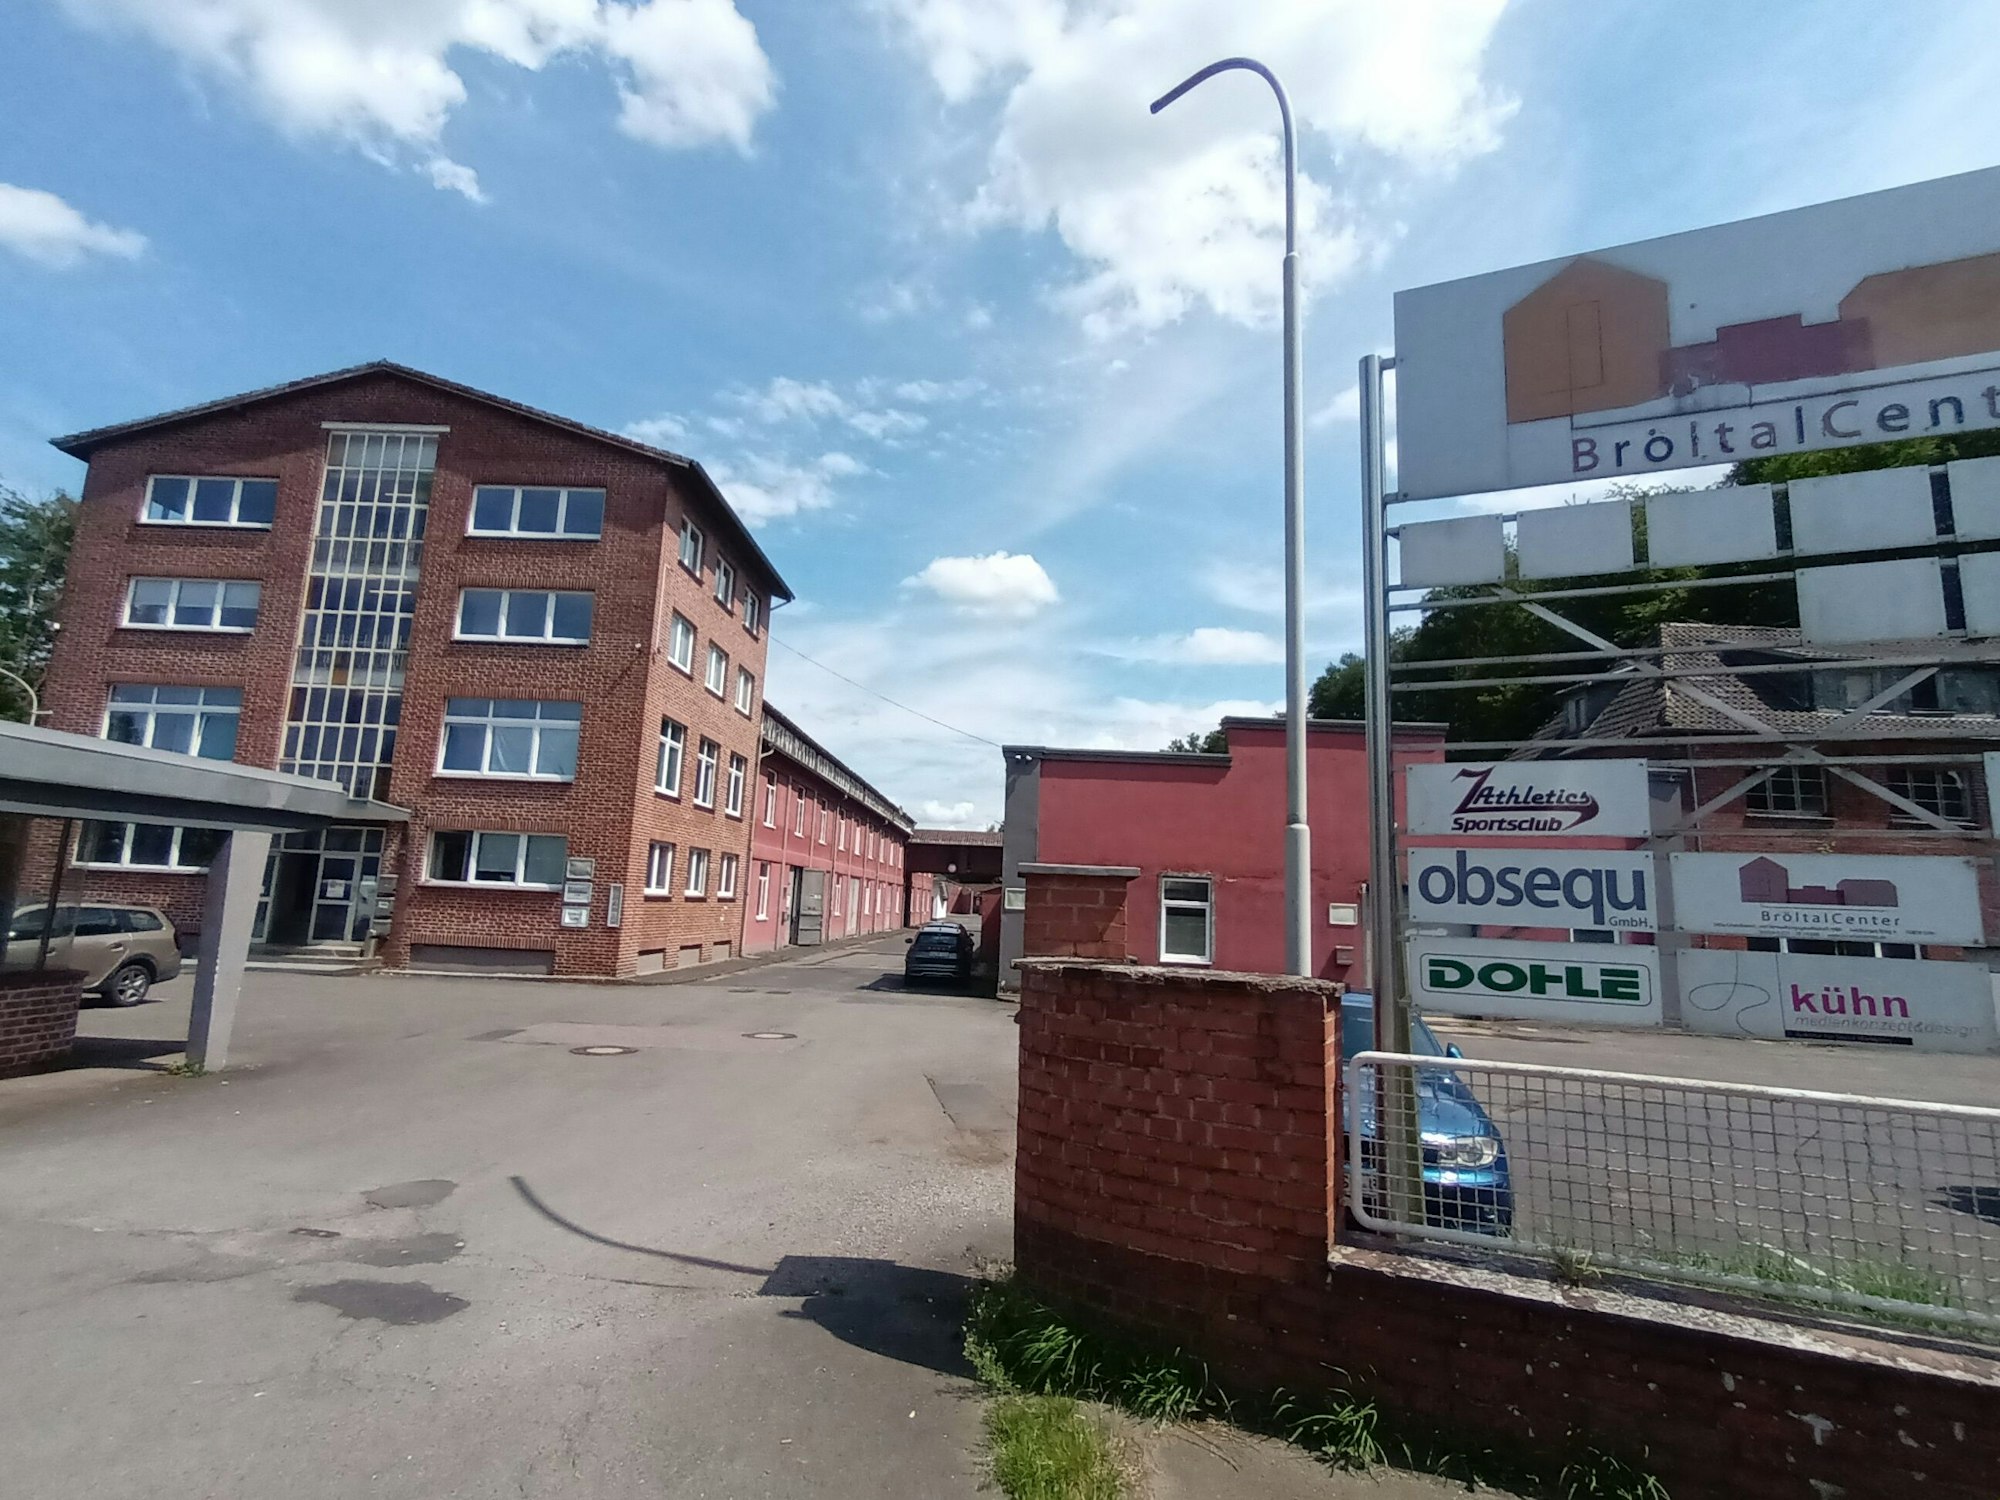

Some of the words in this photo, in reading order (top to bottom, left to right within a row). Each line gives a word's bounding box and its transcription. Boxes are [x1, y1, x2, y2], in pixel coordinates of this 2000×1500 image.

[1451, 817, 1563, 833] Sportsclub
[1418, 850, 1648, 925] obsequ
[1609, 916, 1648, 928] GmbH
[1761, 910, 1900, 926] BröltalCenter
[1429, 959, 1640, 1001] DOHLE
[1791, 984, 1910, 1018] kühn
[1793, 1015, 1981, 1039] medienkonzept&desgn
